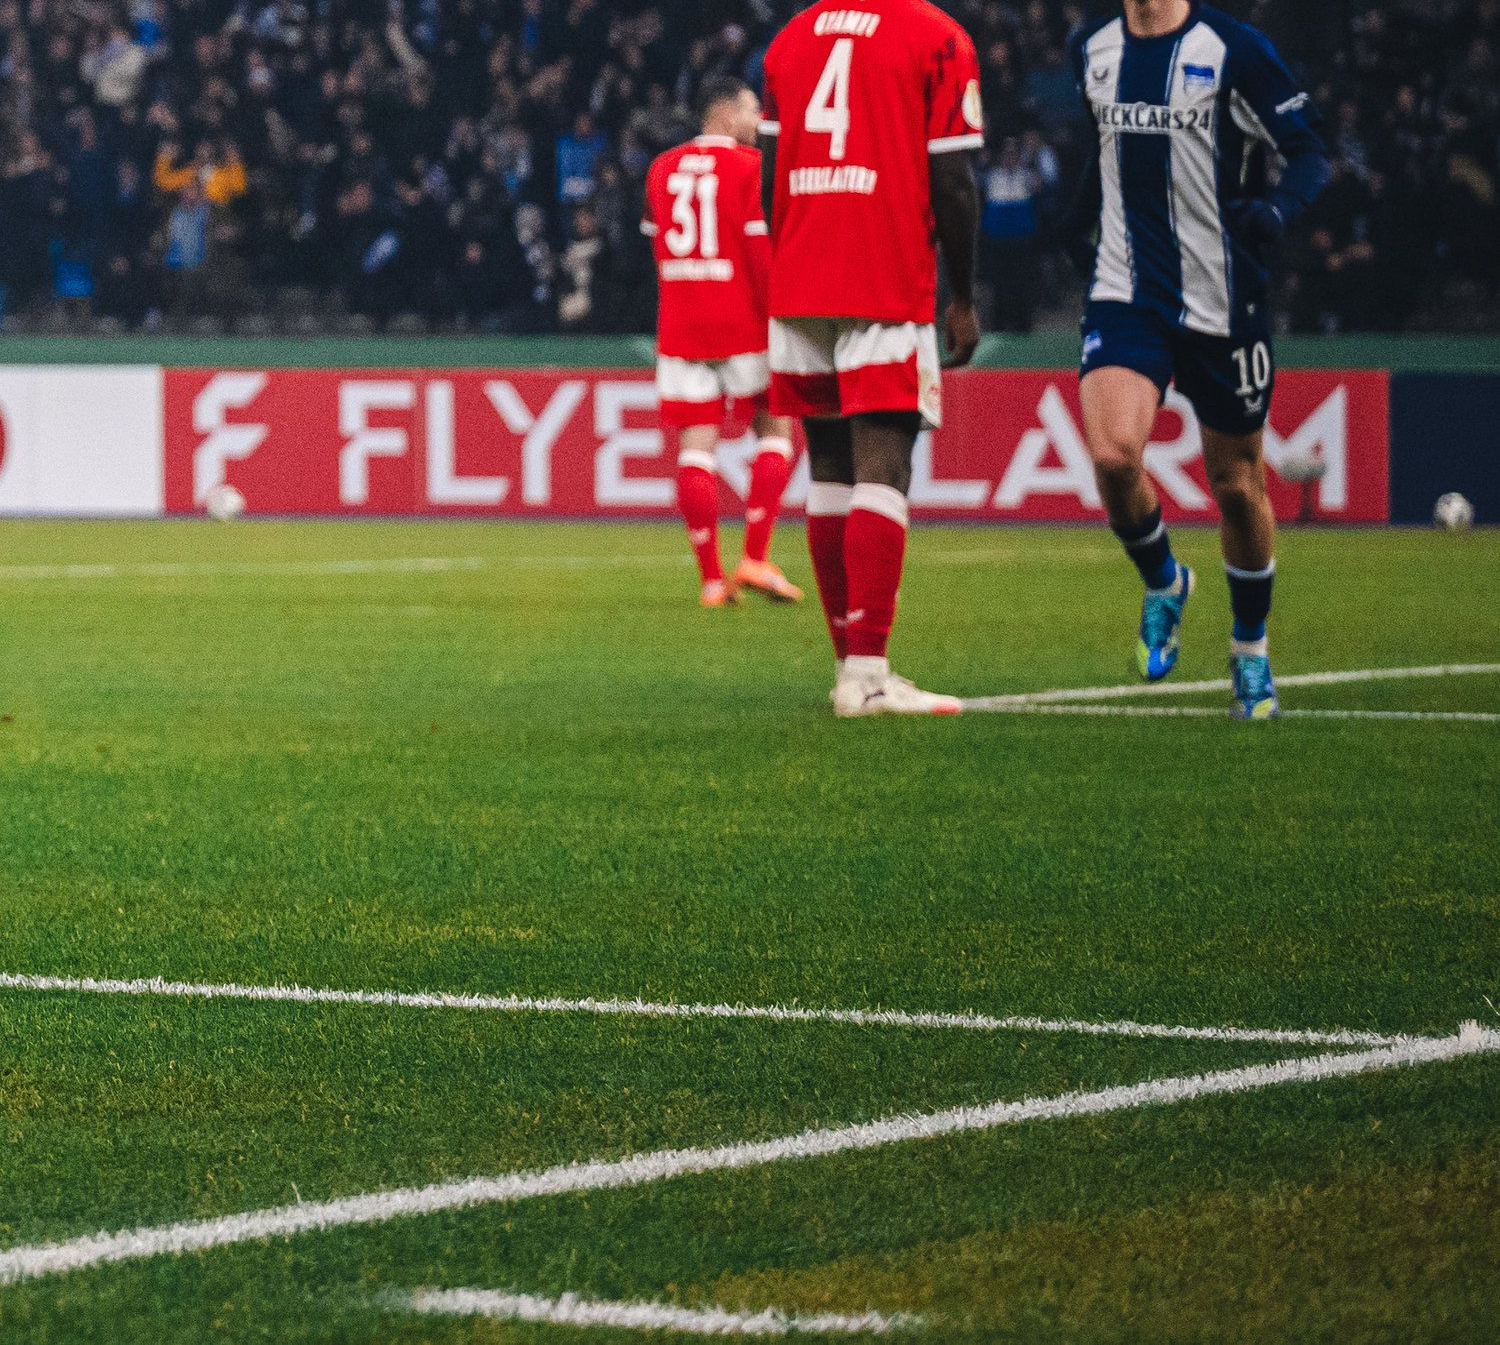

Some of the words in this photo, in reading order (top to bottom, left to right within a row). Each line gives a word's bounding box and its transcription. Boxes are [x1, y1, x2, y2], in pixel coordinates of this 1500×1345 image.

[804, 37, 854, 161] 4
[1094, 103, 1212, 131] ECKCARS24
[665, 172, 719, 258] 31
[1231, 340, 1270, 395] 10
